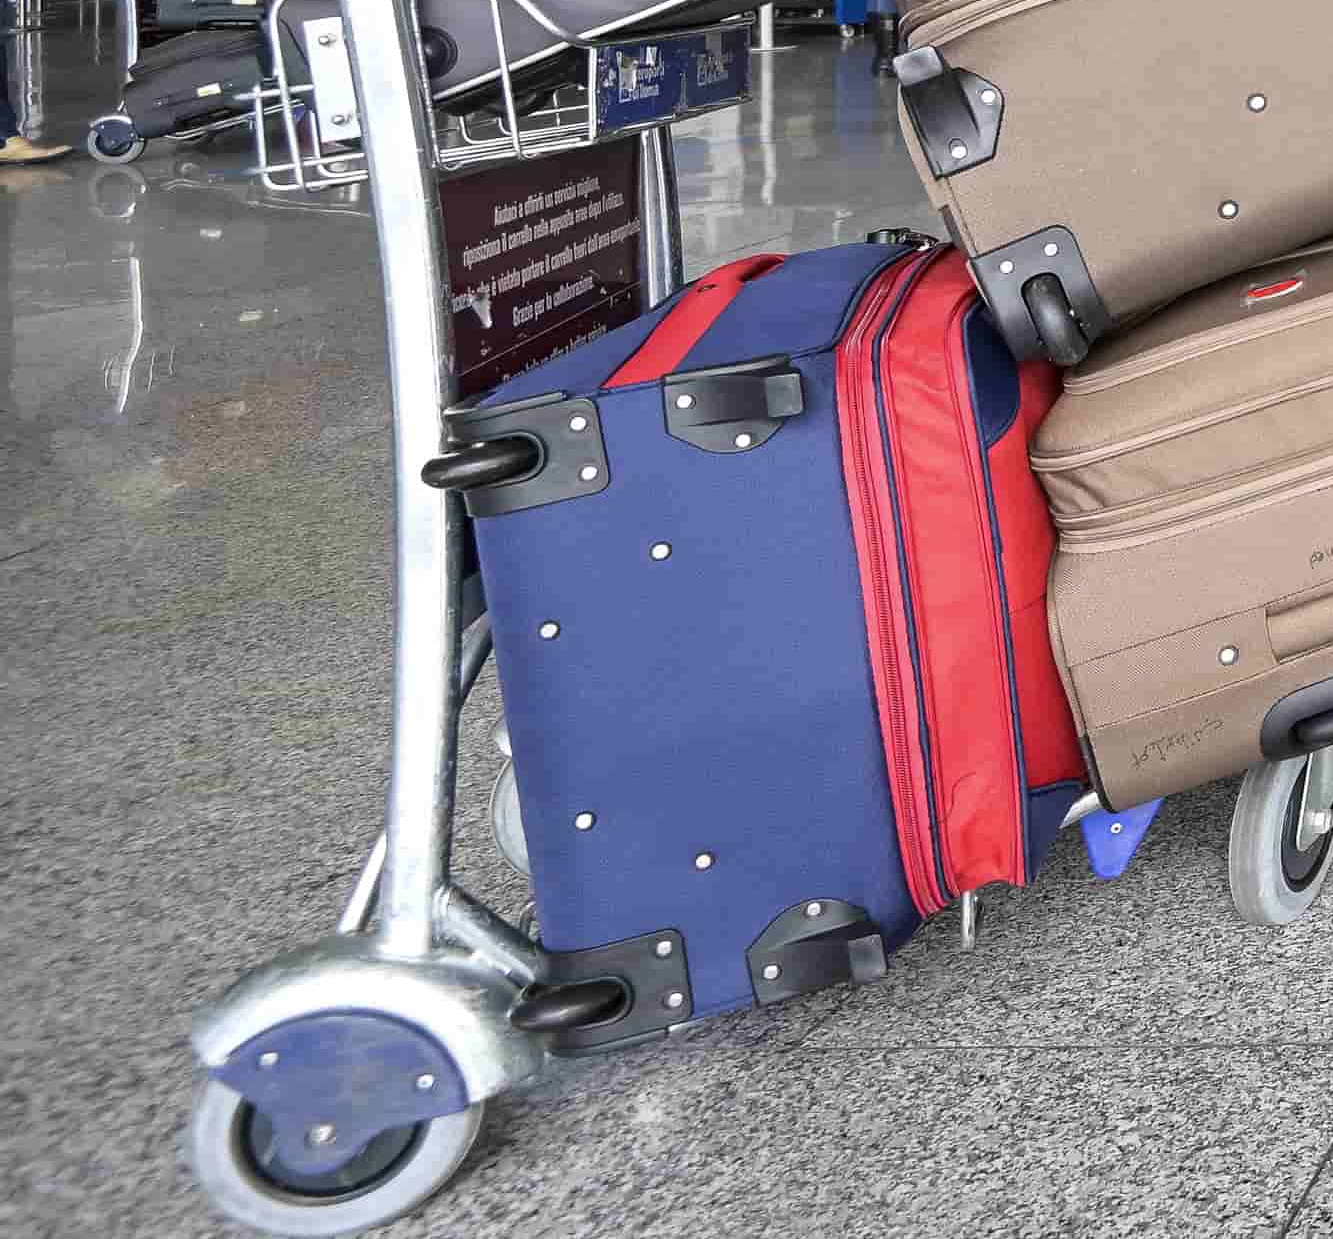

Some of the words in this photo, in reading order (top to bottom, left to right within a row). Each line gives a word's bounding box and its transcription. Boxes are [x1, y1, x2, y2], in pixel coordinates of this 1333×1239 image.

[545, 192, 553, 209] un
[501, 232, 507, 252] il
[508, 224, 533, 249] carrello
[498, 268, 521, 294] vietato
[521, 258, 545, 288] portare
[545, 253, 550, 273] il
[550, 244, 574, 269] carrello
[512, 301, 534, 327] Grazie
[534, 298, 545, 321] per
[546, 291, 552, 310] la
